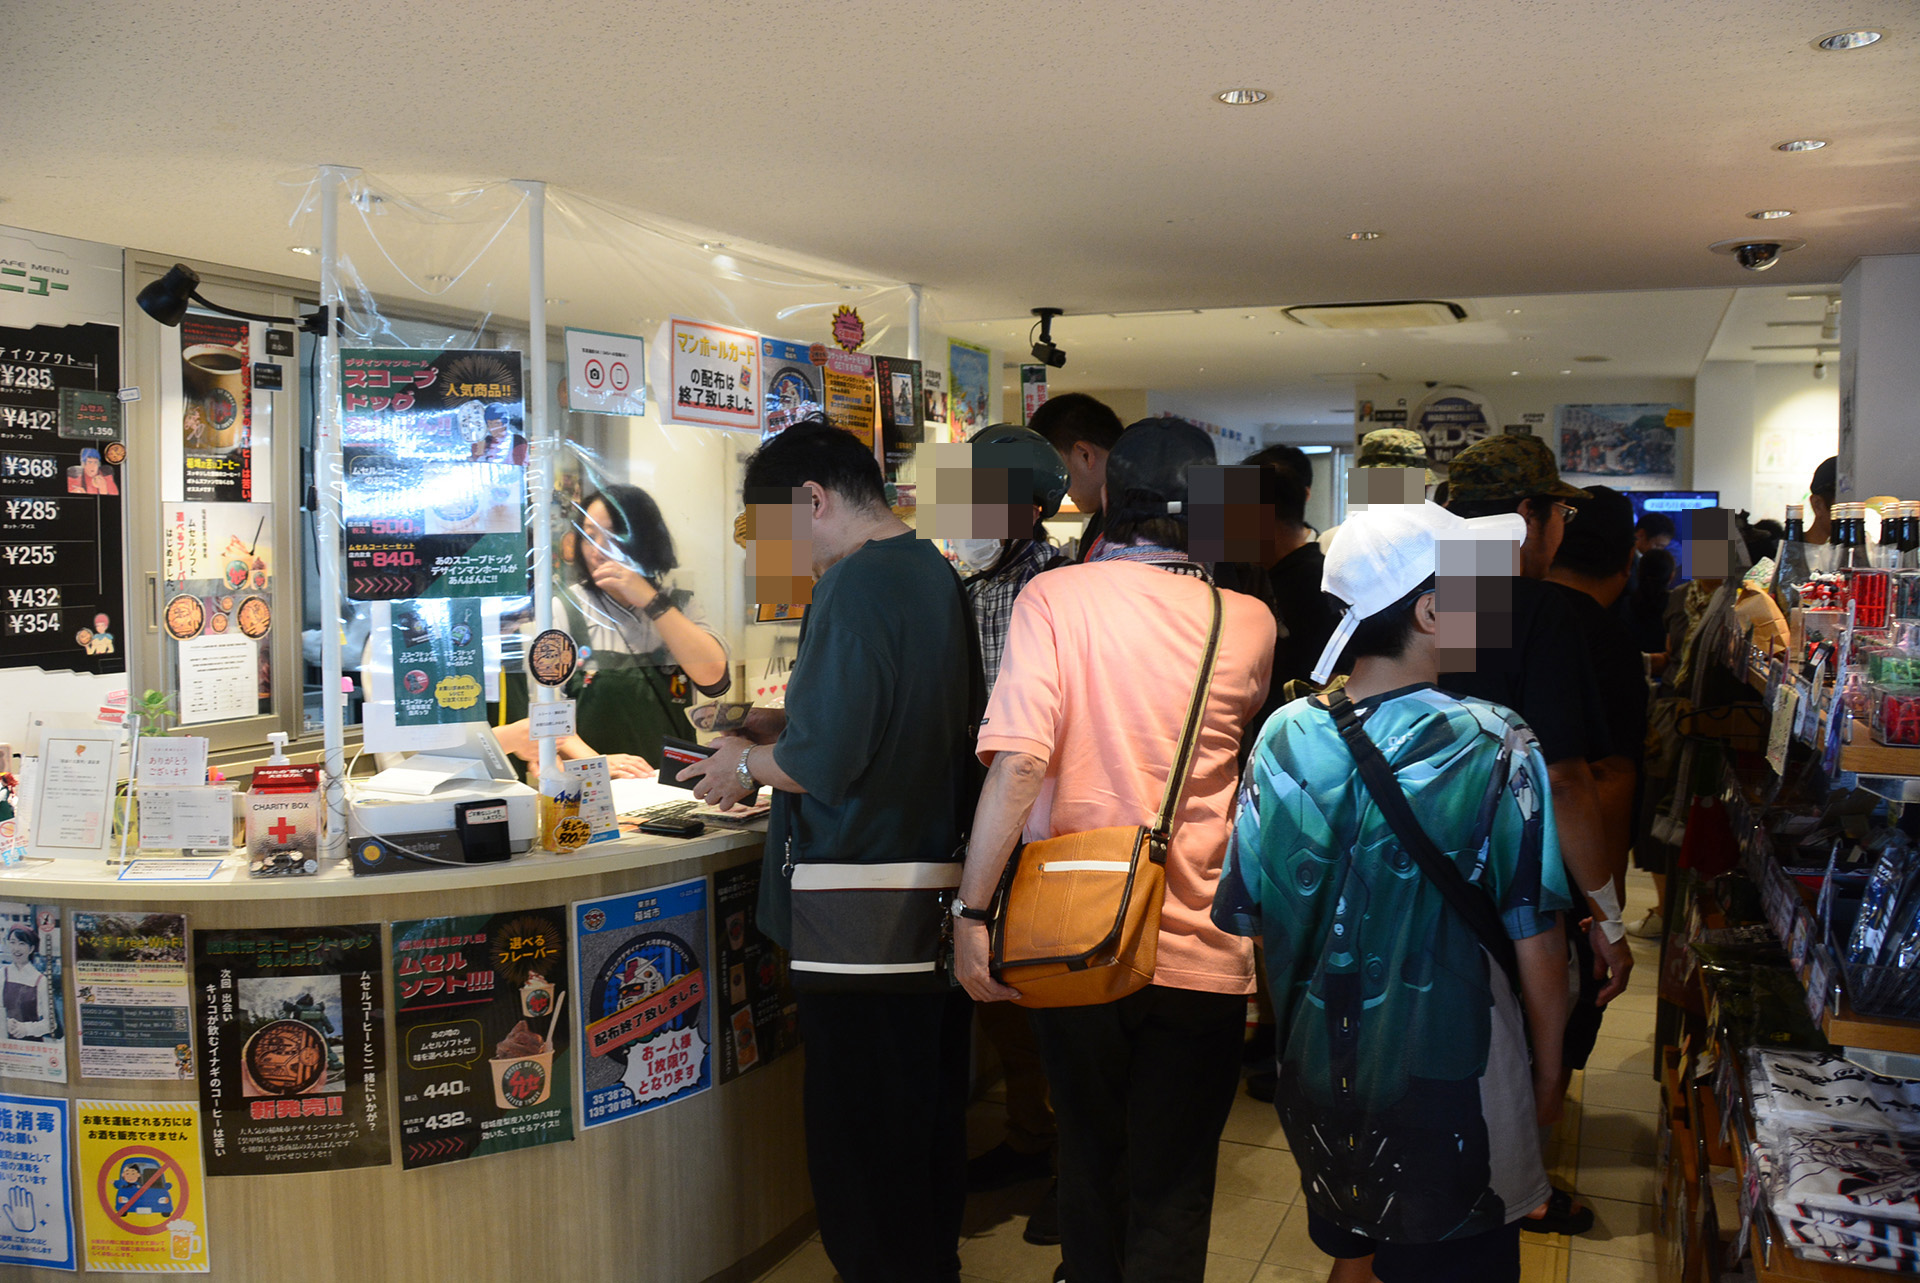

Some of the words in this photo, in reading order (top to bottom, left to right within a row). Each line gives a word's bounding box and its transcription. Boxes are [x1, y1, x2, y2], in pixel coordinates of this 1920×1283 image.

[31, 264, 70, 275] MENU
[676, 332, 756, 364] マンホールカード
[345, 358, 429, 367] デザインマンホール
[1, 364, 51, 388] ¥285
[344, 366, 439, 388] スコープ
[690, 368, 734, 390] の配布は
[446, 383, 511, 397] 人気商品!!
[678, 385, 753, 414] 終了致しました
[80, 403, 105, 413] ムセル
[345, 390, 416, 412] ドッグ
[4, 408, 52, 431] ¥412
[5, 456, 53, 478] ¥368
[6, 500, 57, 521] ¥285
[5, 545, 55, 565] ¥255
[189, 519, 197, 577] ムセルソフト
[348, 543, 416, 551] ムセルコーヒーセット
[372, 551, 422, 567] 840円
[435, 554, 514, 566] あのスコープドッグ
[431, 564, 518, 576] デザインマンホールが
[8, 587, 59, 608] ¥432
[10, 612, 60, 634] ¥354
[149, 757, 188, 766] ありがとう
[150, 768, 189, 777] ございます
[252, 803, 290, 811] CHARITY
[637, 898, 657, 909] 東京都
[634, 907, 661, 921] 稲城市
[78, 936, 114, 948] いなぎ
[116, 936, 145, 948] Free
[148, 936, 184, 949] Wi-Fi
[509, 935, 546, 949] 選べる
[398, 951, 469, 977] ムセル
[498, 948, 559, 964] フレーバー
[220, 969, 232, 989] 次回
[399, 970, 496, 1000] ソフト!!!!
[221, 993, 234, 1022] 出会い
[593, 982, 700, 1047] 配布終了致しました
[420, 1037, 472, 1051] ムセルソフトが
[641, 1033, 693, 1062] お一人様
[206, 983, 226, 1157] キリコが飲むイナギのコーヒーは苦い
[648, 1051, 689, 1077] 1枚限り
[423, 1080, 471, 1099] 440円
[638, 1064, 695, 1096] となります
[250, 1096, 343, 1120] 新発売!!
[0, 1108, 55, 1133] 指消毒
[83, 1115, 192, 1127] お車を運転される方には
[425, 1111, 472, 1130] 432円
[88, 1130, 189, 1141] お酒を販売できません
